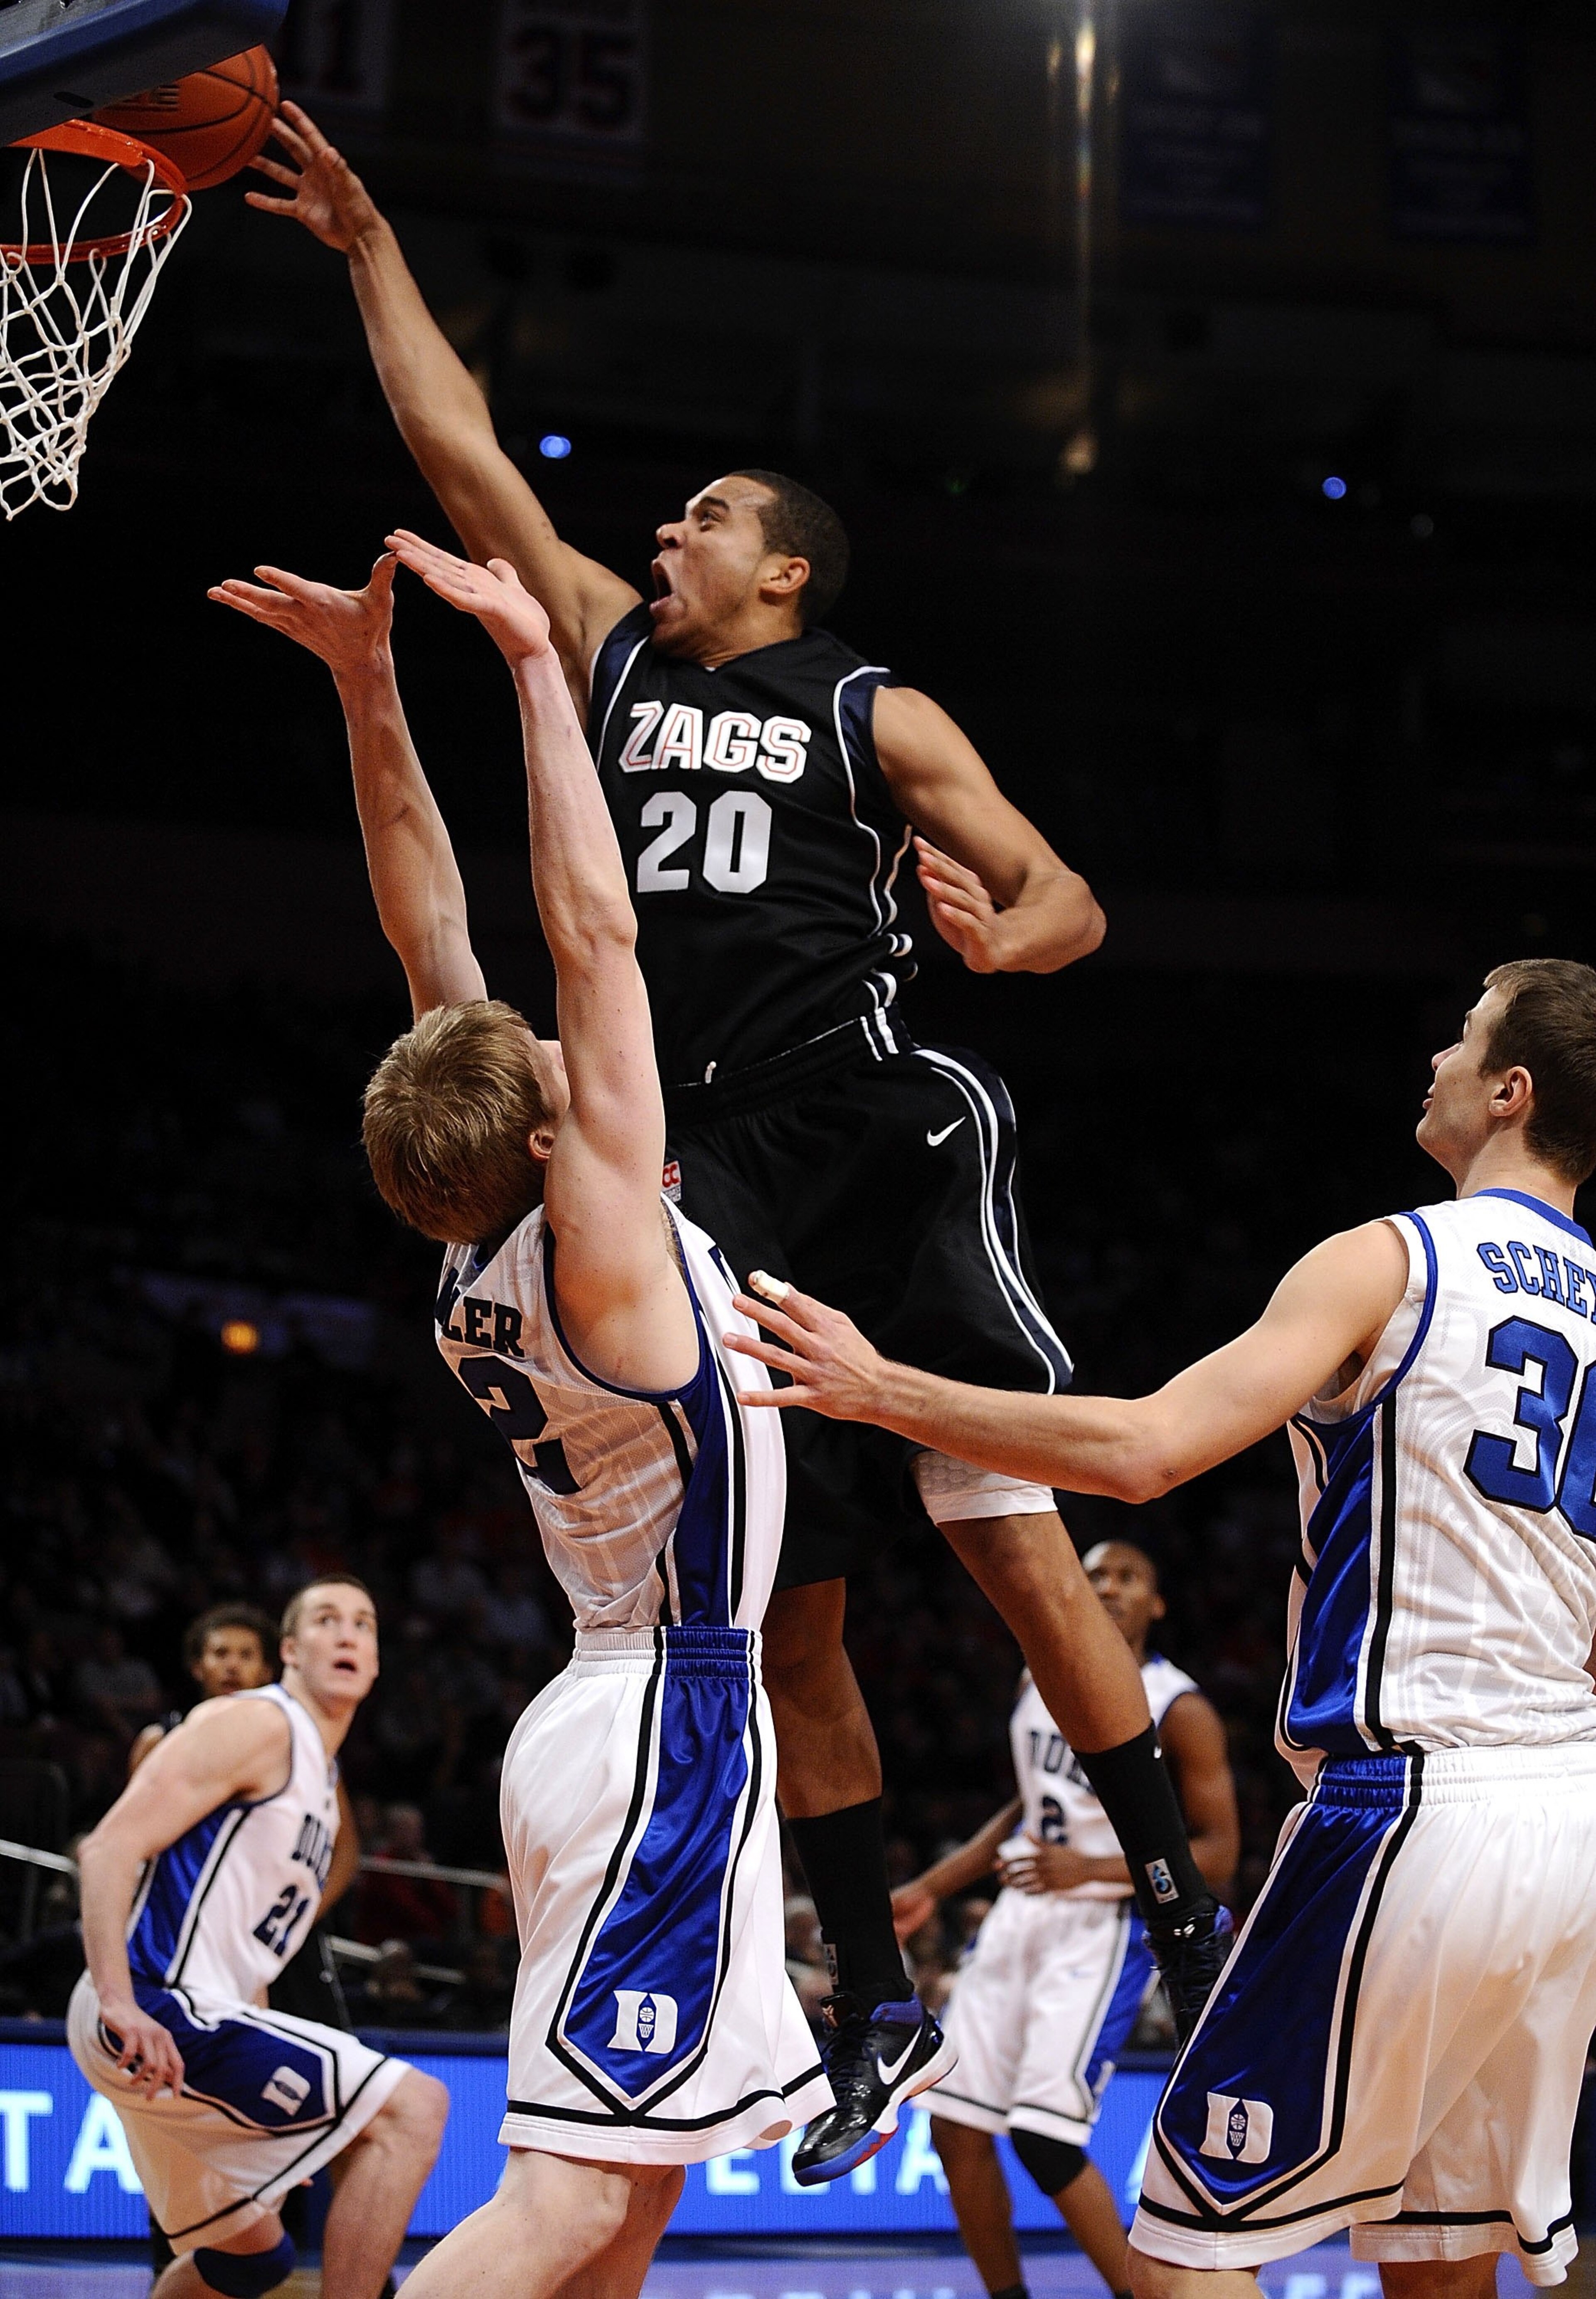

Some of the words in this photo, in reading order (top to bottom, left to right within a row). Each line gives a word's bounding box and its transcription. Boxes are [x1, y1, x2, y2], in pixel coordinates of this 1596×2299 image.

[512, 26, 631, 124] 35
[618, 701, 812, 783] ZAGS
[637, 790, 772, 894] 20
[1041, 1795, 1068, 1845] 2
[253, 1884, 309, 1956] 21
